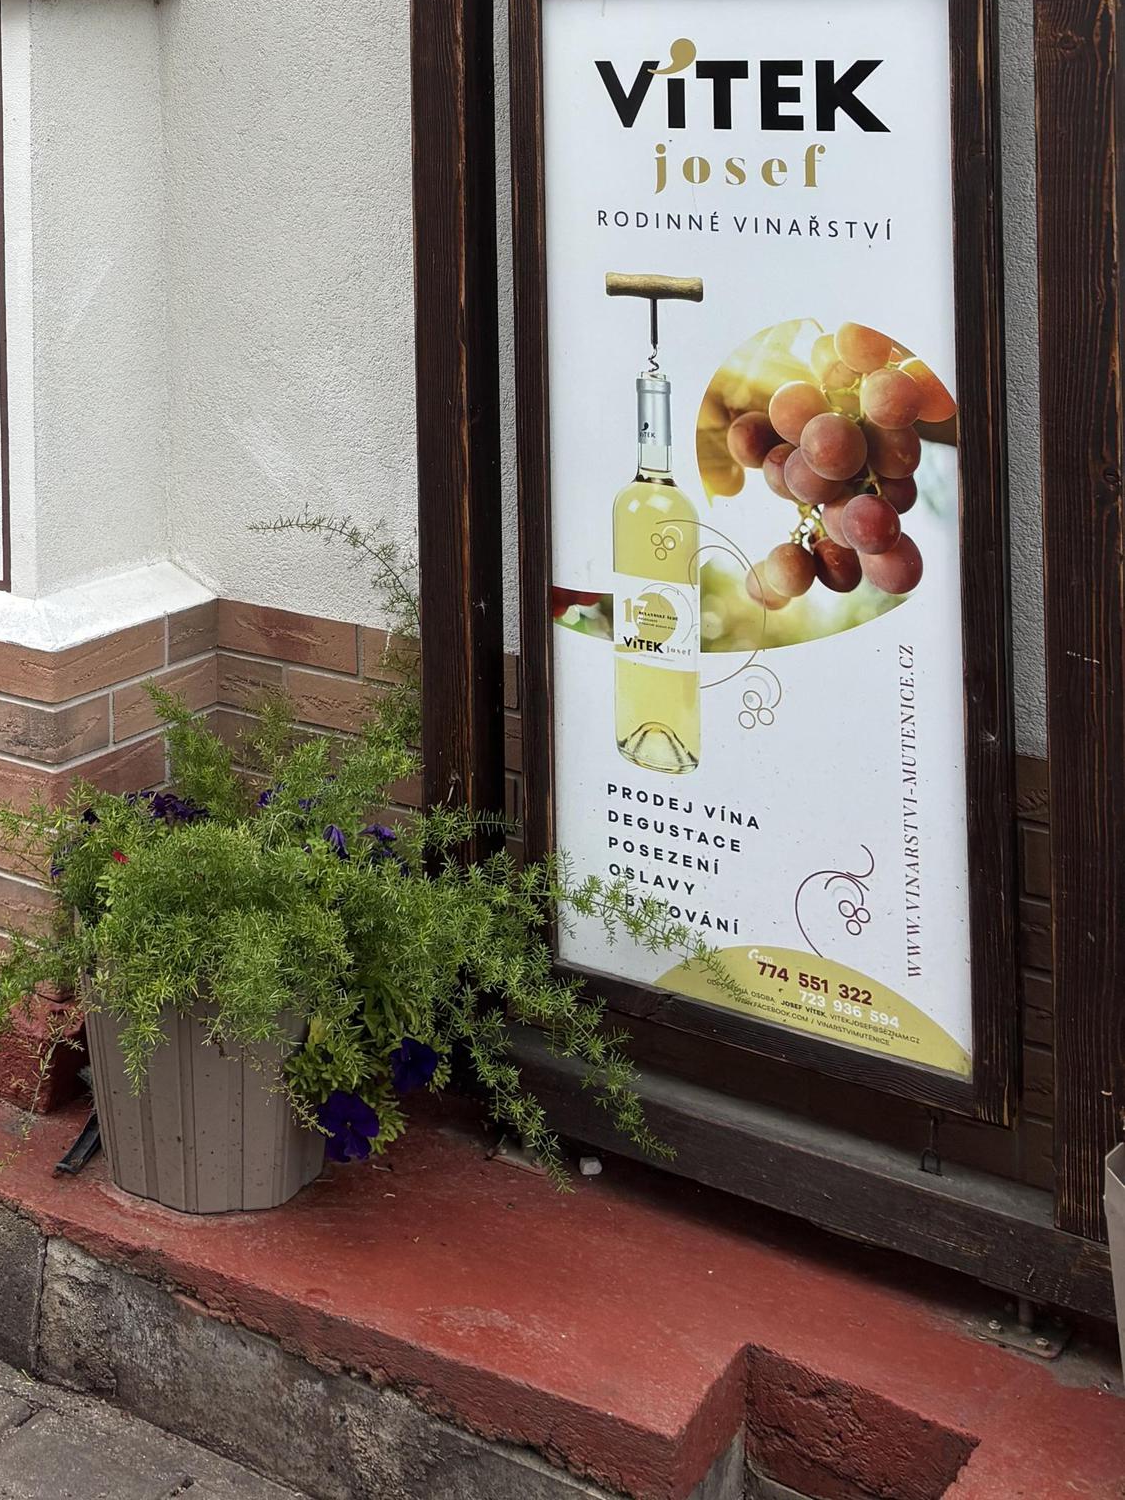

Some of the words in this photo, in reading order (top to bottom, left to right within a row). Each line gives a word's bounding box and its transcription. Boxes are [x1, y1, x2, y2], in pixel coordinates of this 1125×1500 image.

[653, 143, 826, 194] josef
[597, 209, 720, 232] RODINNÉ
[733, 215, 892, 241] VINAŘSTVÍ
[607, 783, 694, 815] PRODEJ
[703, 803, 761, 830] VÍNA
[898, 644, 923, 977] WWW.VINARSTVI-MUTENICE.CZ
[607, 810, 742, 853] DEGUSTACE
[607, 836, 720, 876] POSEZENÍ
[609, 863, 695, 896] OSLAVY
[757, 961, 789, 983] 774
[798, 972, 829, 993] 551
[838, 983, 873, 1005] 322
[780, 1000, 803, 1011] JOSEF
[799, 990, 826, 1008] 723
[833, 1000, 863, 1018] 936
[869, 1010, 900, 1029] 594
